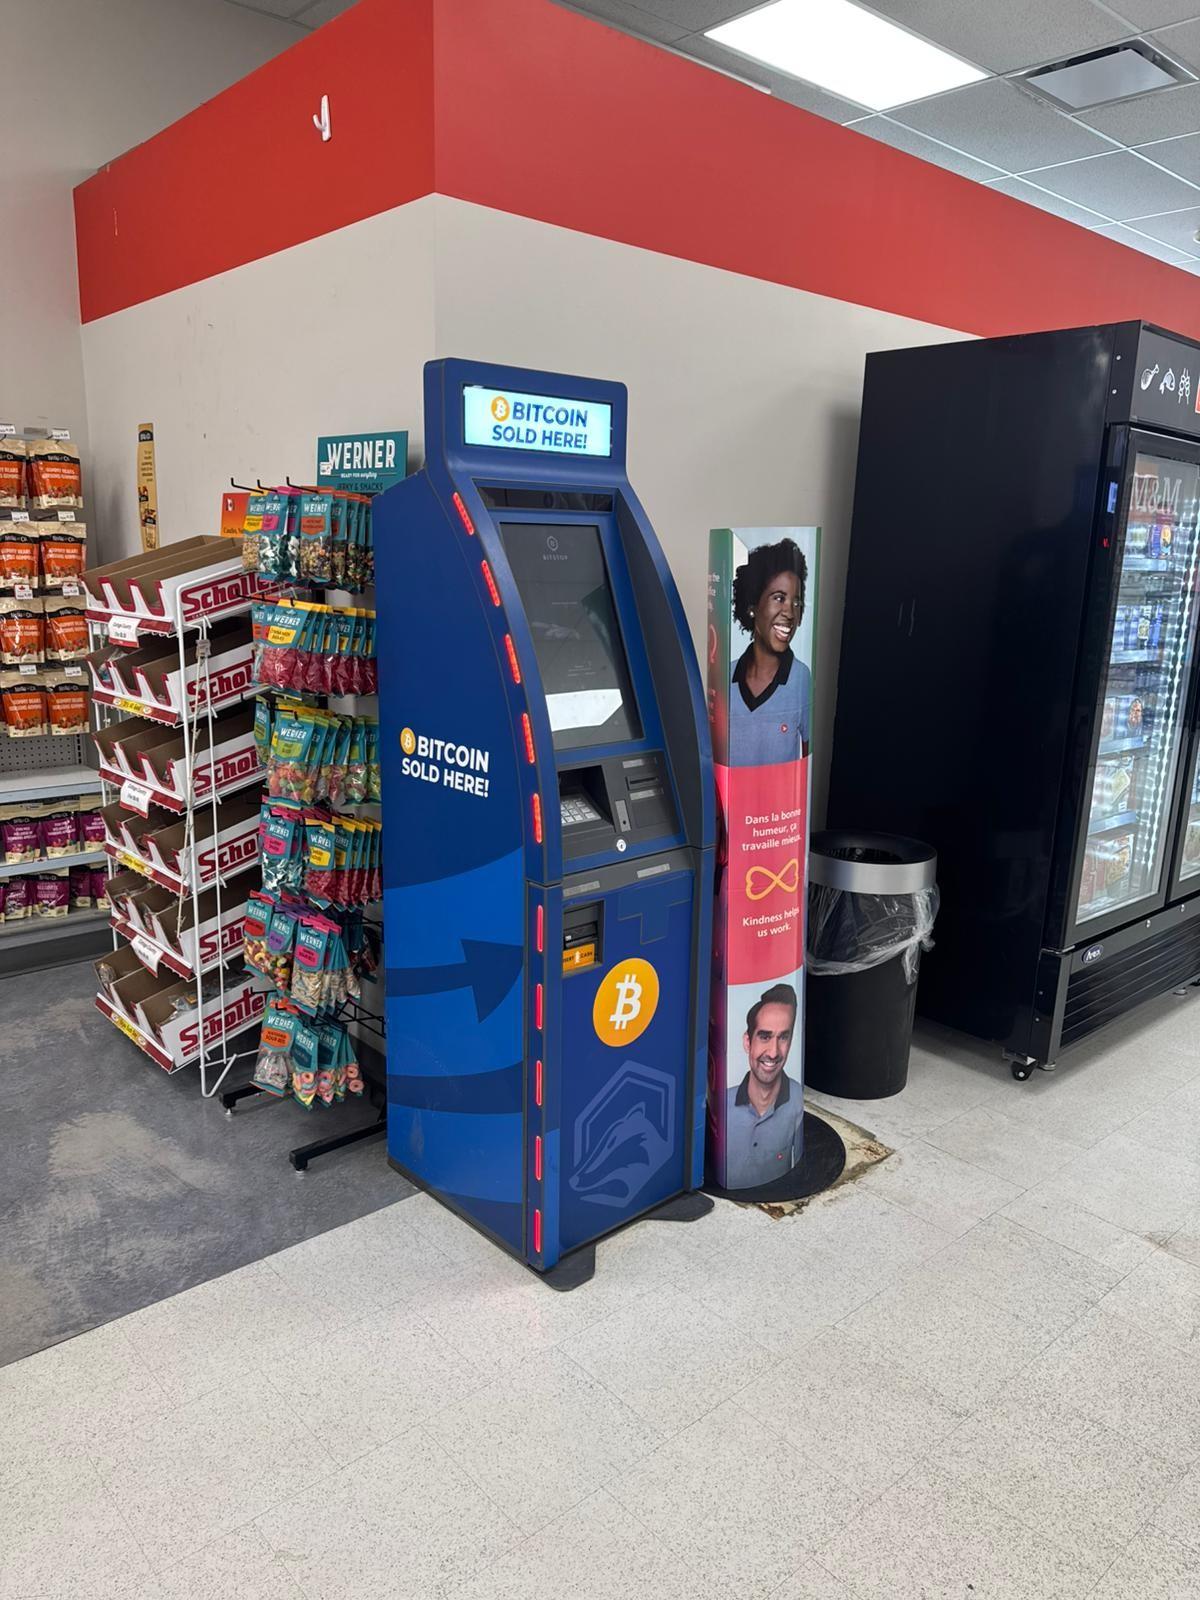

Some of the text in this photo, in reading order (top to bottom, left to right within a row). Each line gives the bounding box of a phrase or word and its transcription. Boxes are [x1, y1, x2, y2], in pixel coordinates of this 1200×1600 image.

[512, 401, 588, 427] BITCOIN
[492, 424, 588, 450] SOLD HERE!
[327, 439, 396, 470] WERNER
[417, 735, 489, 773] BITCOIN
[401, 757, 490, 798] SOLD HERE!
[745, 808, 802, 825] Dans la bonne
[752, 824, 789, 837] humeur,
[741, 838, 780, 851] travaille
[742, 906, 800, 927] Kindness helps
[757, 929, 768, 938] us
